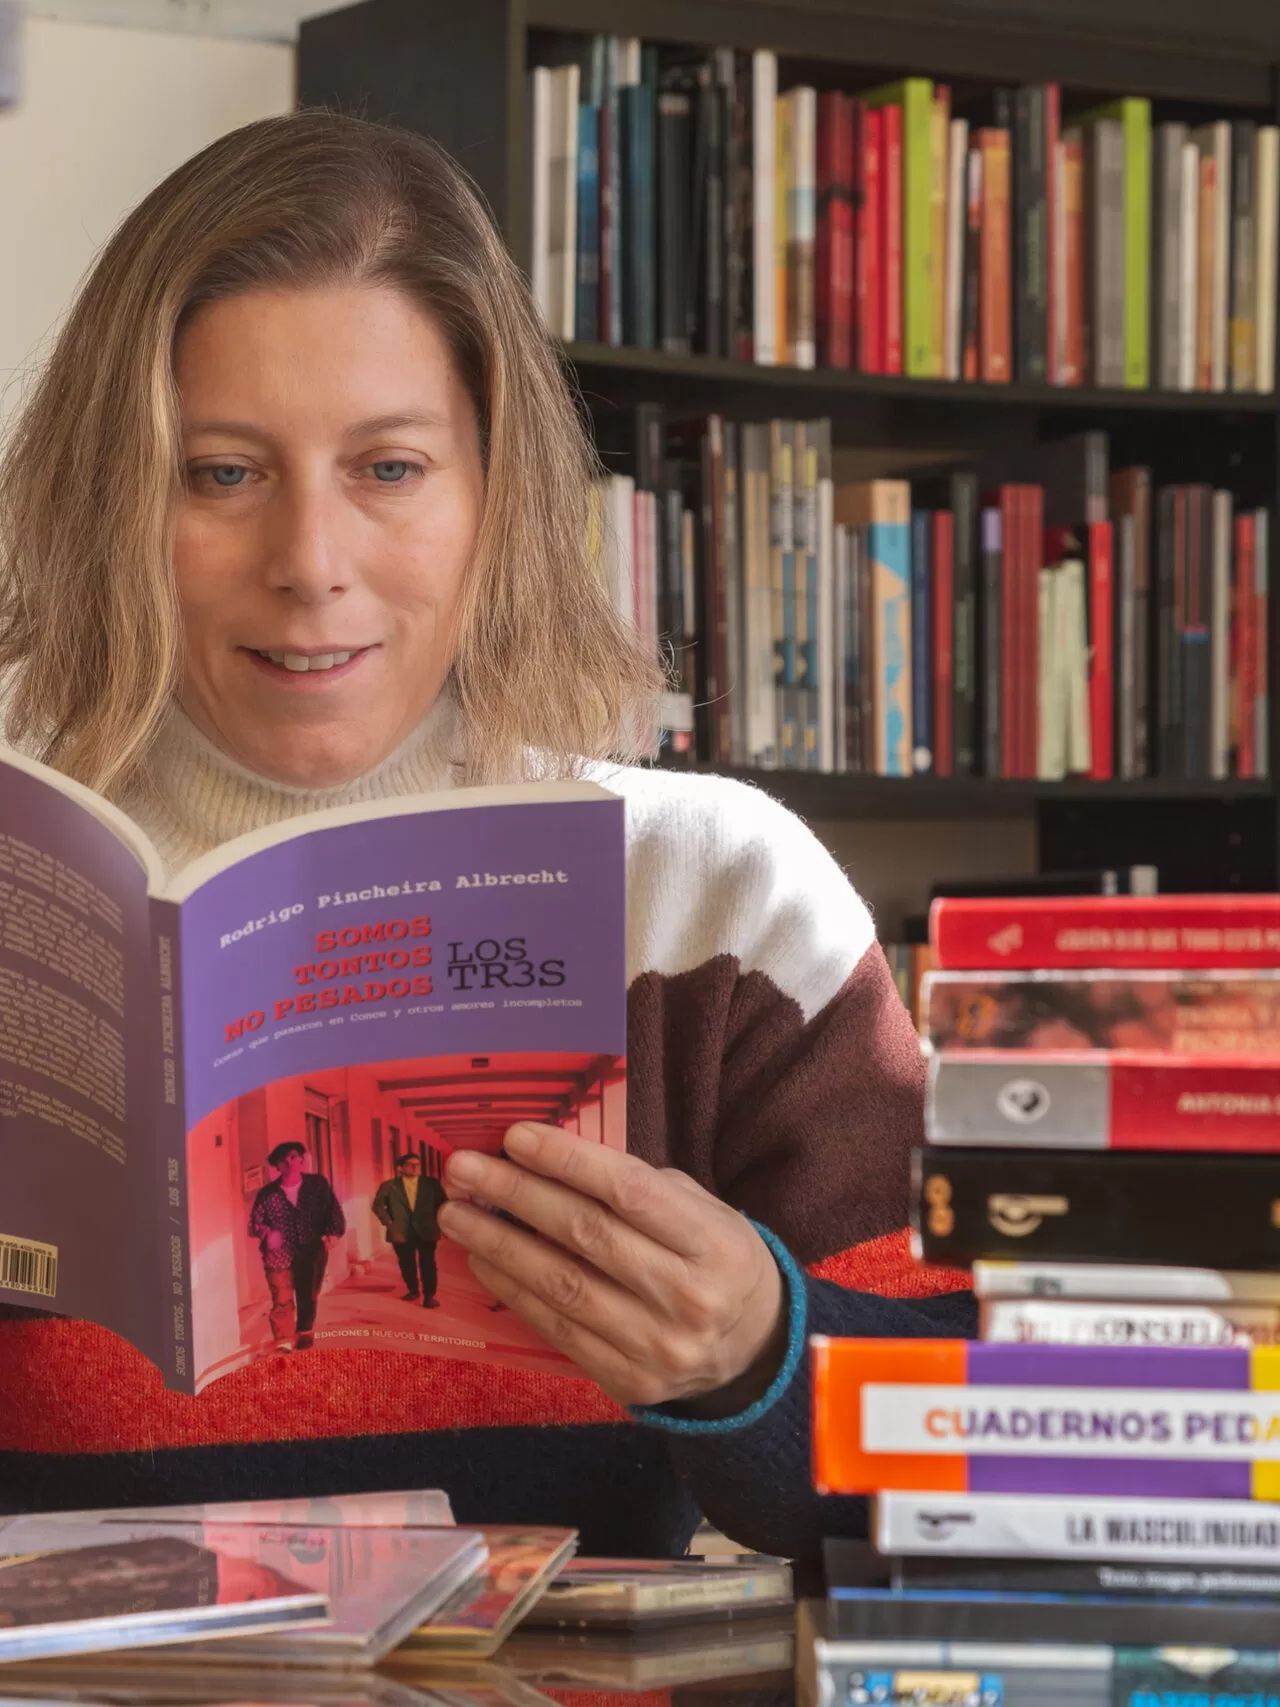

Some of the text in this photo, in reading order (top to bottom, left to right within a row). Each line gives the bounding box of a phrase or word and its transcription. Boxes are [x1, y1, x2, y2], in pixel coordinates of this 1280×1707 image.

[220, 868, 569, 949] Rodrigo Pincheira Albrecht
[314, 916, 432, 953] SOMOS
[448, 938, 528, 965] LOS
[292, 945, 433, 986] TONTOS
[447, 959, 567, 992] TR3S
[223, 975, 434, 1045] NO PESADOS
[247, 1035, 270, 1052] que
[273, 1020, 324, 1041] pasaron
[329, 1015, 345, 1026] en
[350, 1009, 387, 1022] Conce
[407, 1003, 444, 1017] otros
[451, 999, 495, 1011] amores
[502, 996, 583, 1009] incompletos
[1178, 1091, 1268, 1114] ANTONIA
[314, 1328, 487, 1350] EDICIONES NUEVOS TERRITORIOS
[924, 1407, 1171, 1442] CUADERNOS
[1066, 1514, 1095, 1546] LA
